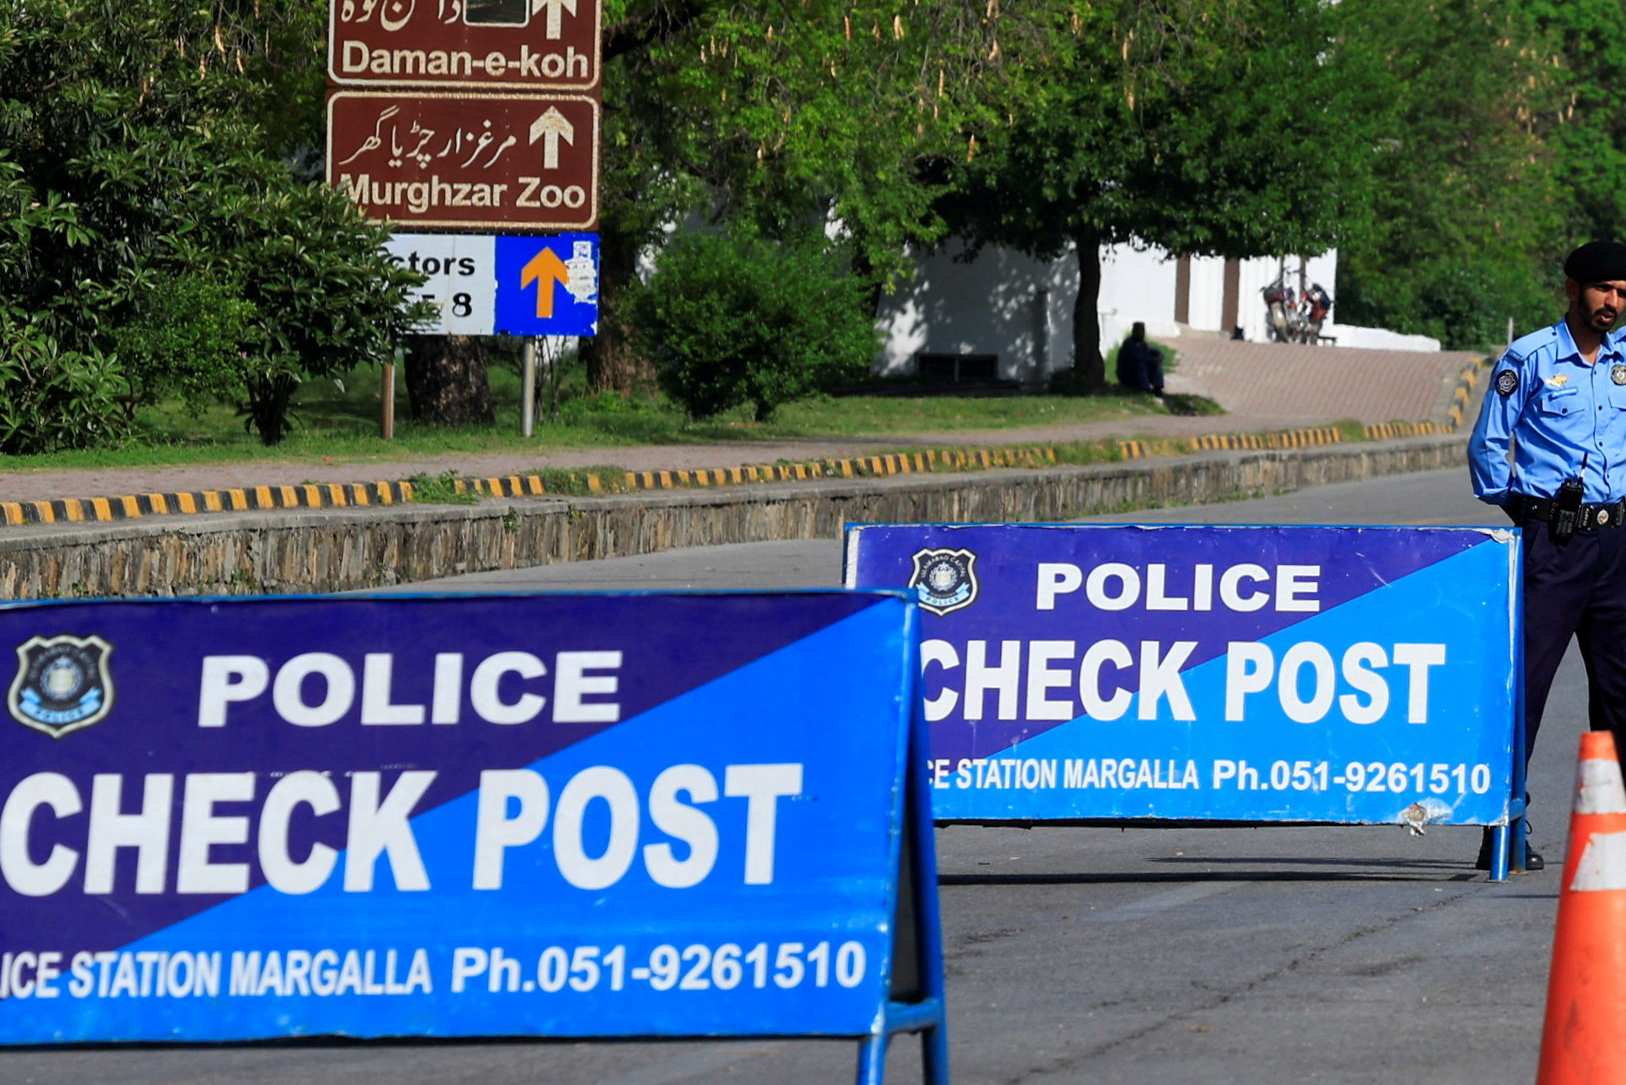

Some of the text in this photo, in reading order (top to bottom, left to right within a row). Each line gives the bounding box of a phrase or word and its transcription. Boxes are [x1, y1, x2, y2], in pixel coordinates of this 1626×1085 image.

[342, 40, 588, 78] Daman-e-koh
[339, 173, 586, 214] Murghzar Zoo
[452, 293, 472, 317] 8
[1036, 563, 1321, 611] POLICE
[198, 650, 622, 728] POLICE
[920, 639, 1446, 725] CHECK POST
[956, 758, 1056, 789] STATION
[1063, 758, 1199, 790] MARGALLA
[1212, 759, 1492, 794] Ph.051-9261510
[0, 763, 804, 897] CHECK POST
[0, 941, 867, 999] ICE STATION MARGALLA Ph.051-9261510
